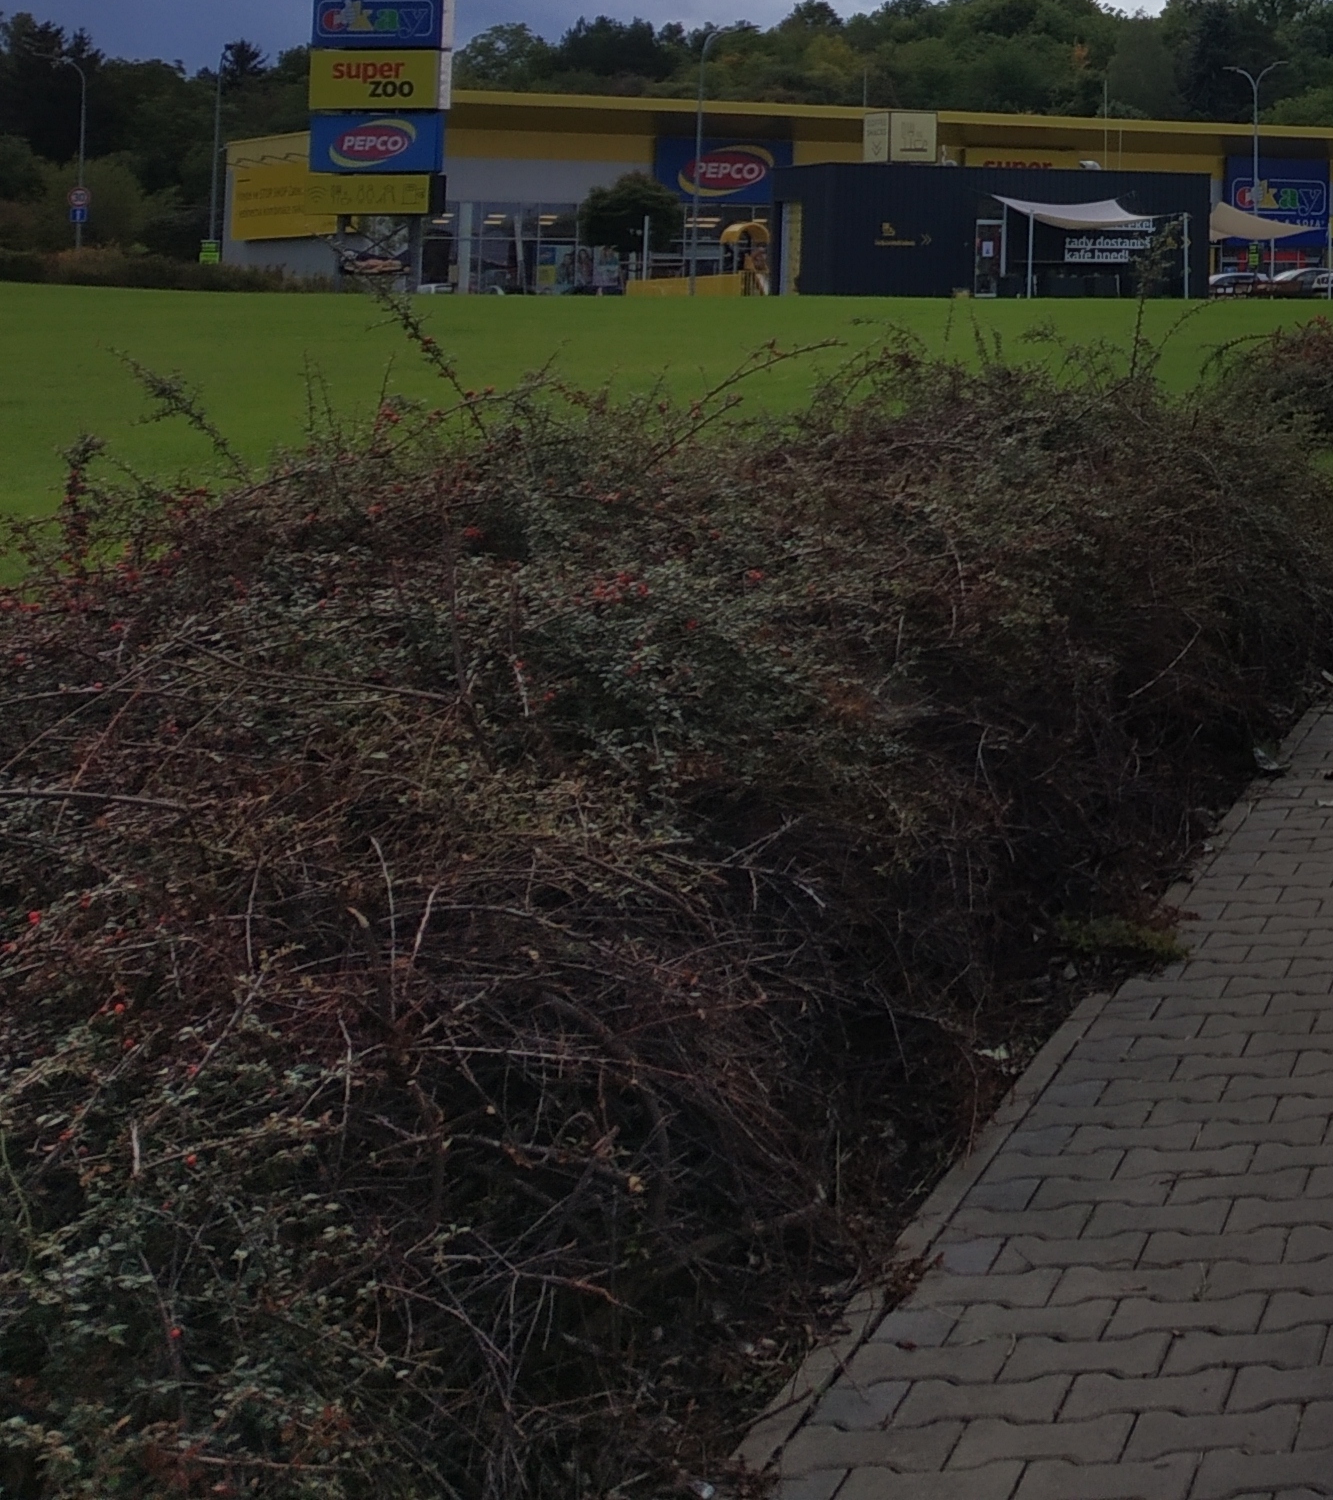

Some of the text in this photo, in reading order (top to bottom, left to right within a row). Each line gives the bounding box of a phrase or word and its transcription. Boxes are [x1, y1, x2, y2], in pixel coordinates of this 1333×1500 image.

[332, 61, 405, 84] super
[342, 135, 403, 151] PEPCO
[693, 162, 759, 179] PEPCO
[1065, 236, 1095, 250] tady
[1065, 249, 1129, 261] kafe hned!
